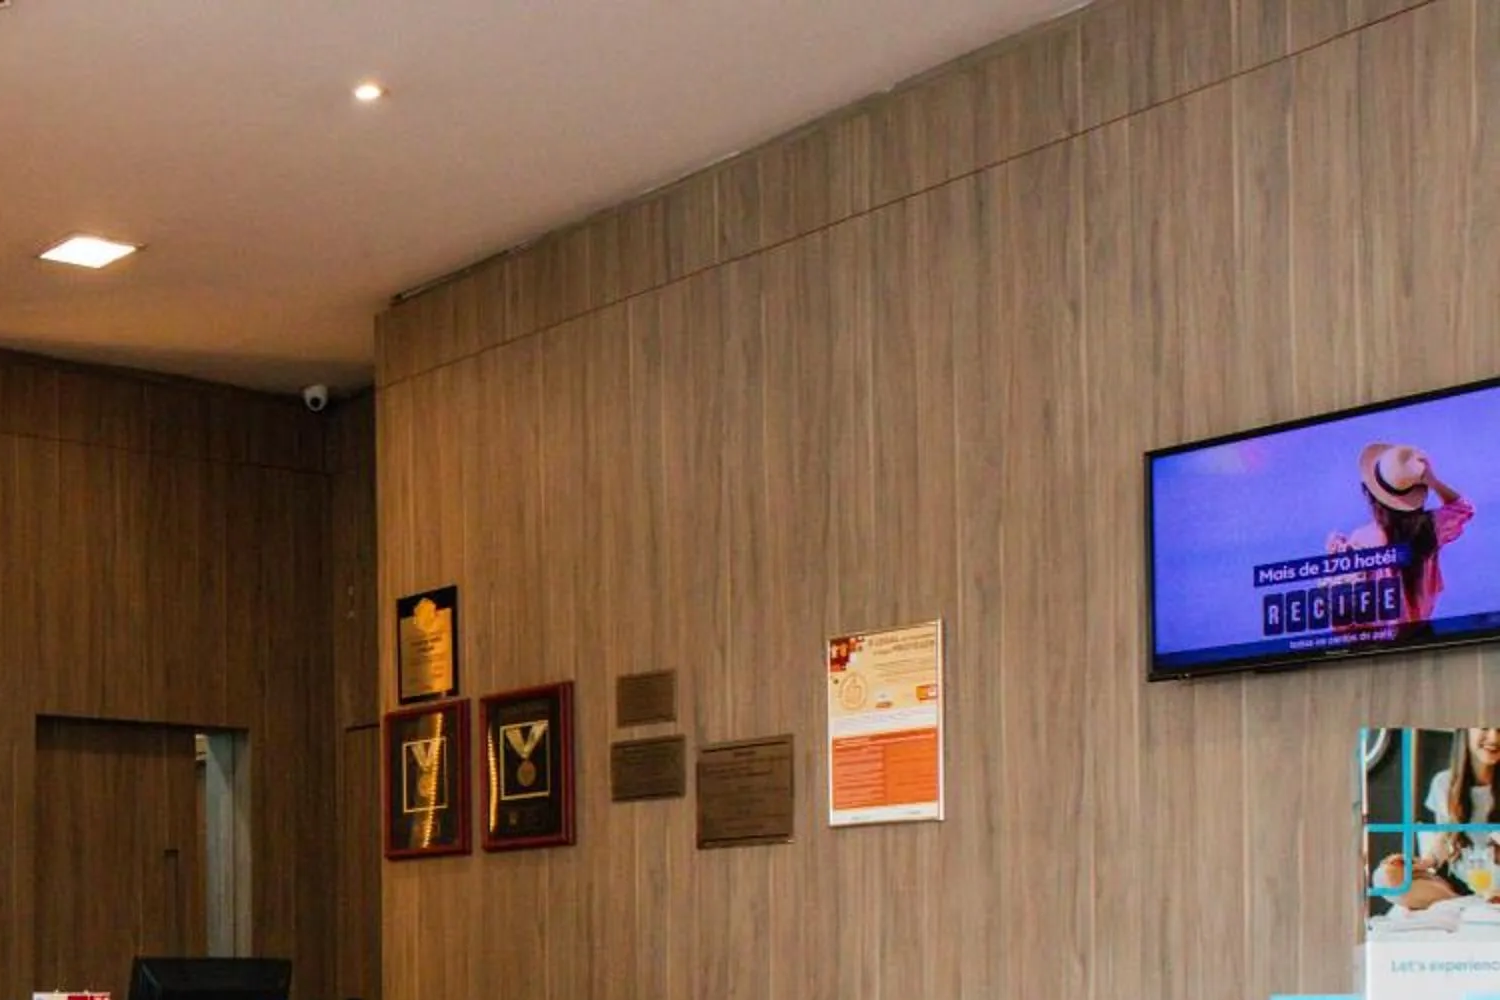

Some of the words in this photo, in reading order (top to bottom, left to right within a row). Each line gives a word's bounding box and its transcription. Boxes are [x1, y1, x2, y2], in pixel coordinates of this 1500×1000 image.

[1259, 564, 1296, 584] Mais
[1299, 561, 1320, 577] de
[1322, 555, 1350, 574] 170
[1268, 587, 1396, 626] RECIFE
